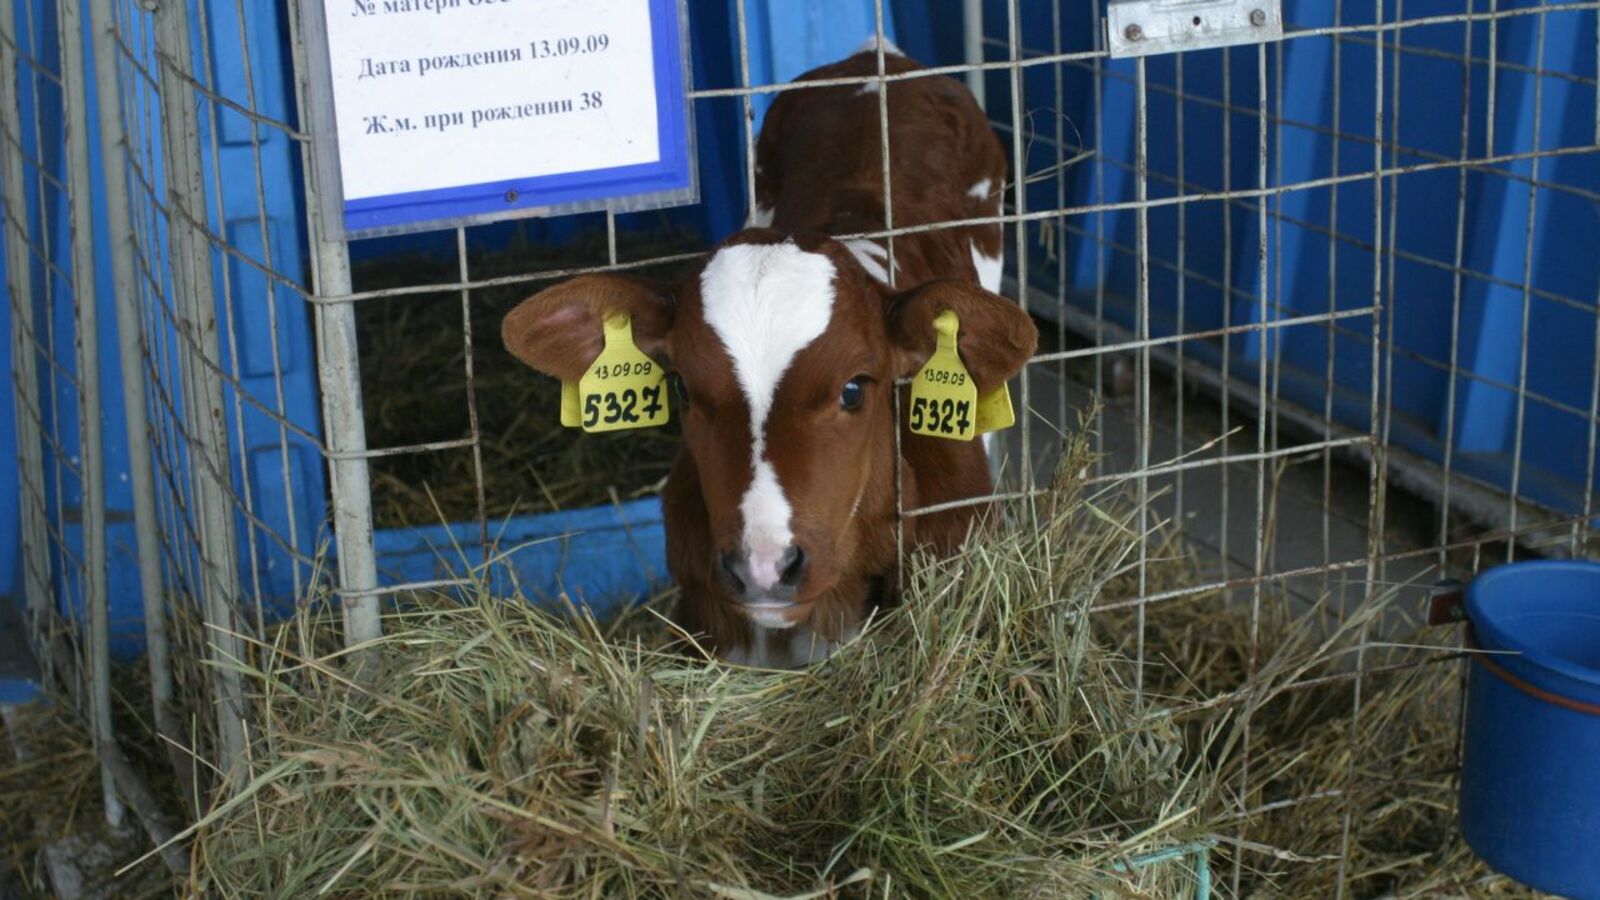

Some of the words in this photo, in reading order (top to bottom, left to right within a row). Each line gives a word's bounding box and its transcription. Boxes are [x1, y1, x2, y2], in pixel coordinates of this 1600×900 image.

[352, 0, 376, 17] №
[357, 59, 411, 81] Дата
[418, 47, 522, 77] рождения
[530, 34, 610, 60] 13.09.09
[363, 115, 418, 135] Ж.м.
[424, 111, 464, 133] при
[472, 99, 573, 129] рождении
[580, 90, 603, 111] 38
[595, 361, 652, 379] 13.09.09
[925, 368, 966, 386] 13.09.09
[583, 385, 662, 428] 5327
[911, 397, 970, 436] 5327
